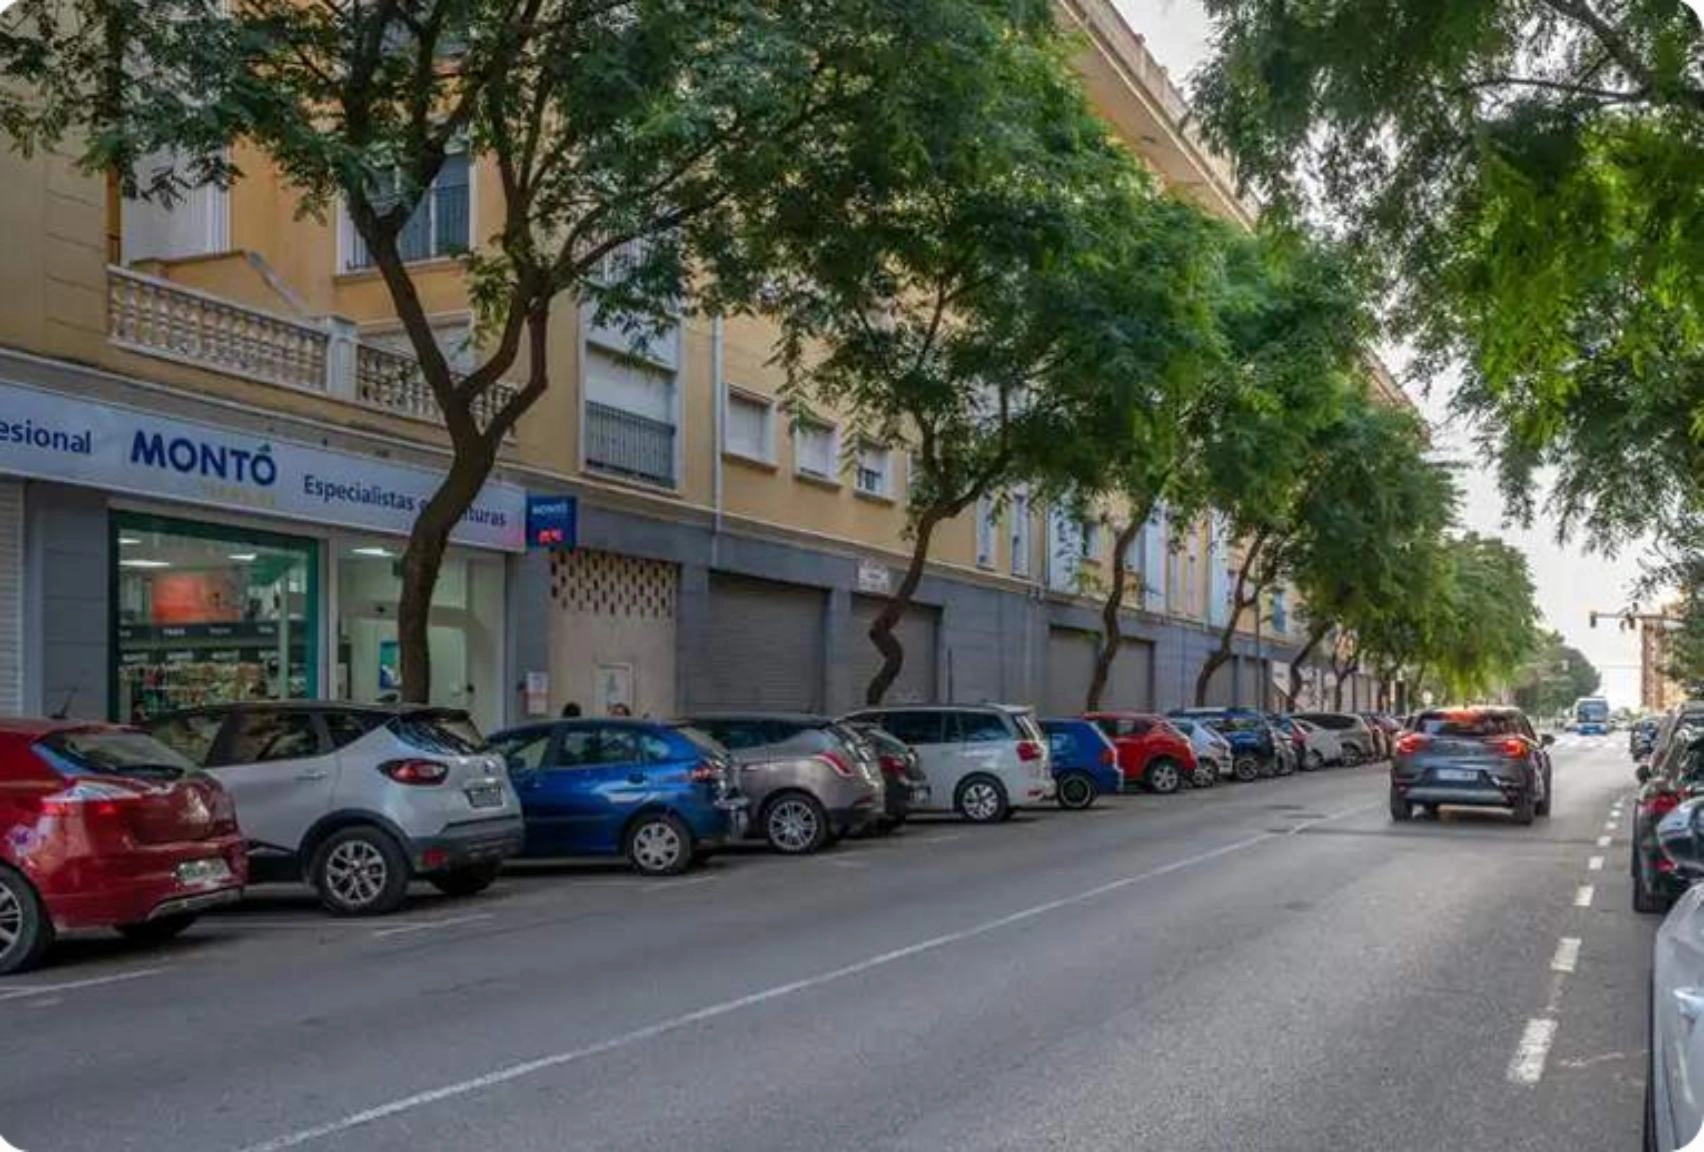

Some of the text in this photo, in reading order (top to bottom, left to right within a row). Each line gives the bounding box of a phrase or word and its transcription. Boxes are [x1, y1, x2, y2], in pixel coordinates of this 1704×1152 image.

[0, 419, 91, 454] esional
[131, 429, 276, 486] MONTÓ
[304, 474, 414, 511] Especialistas
